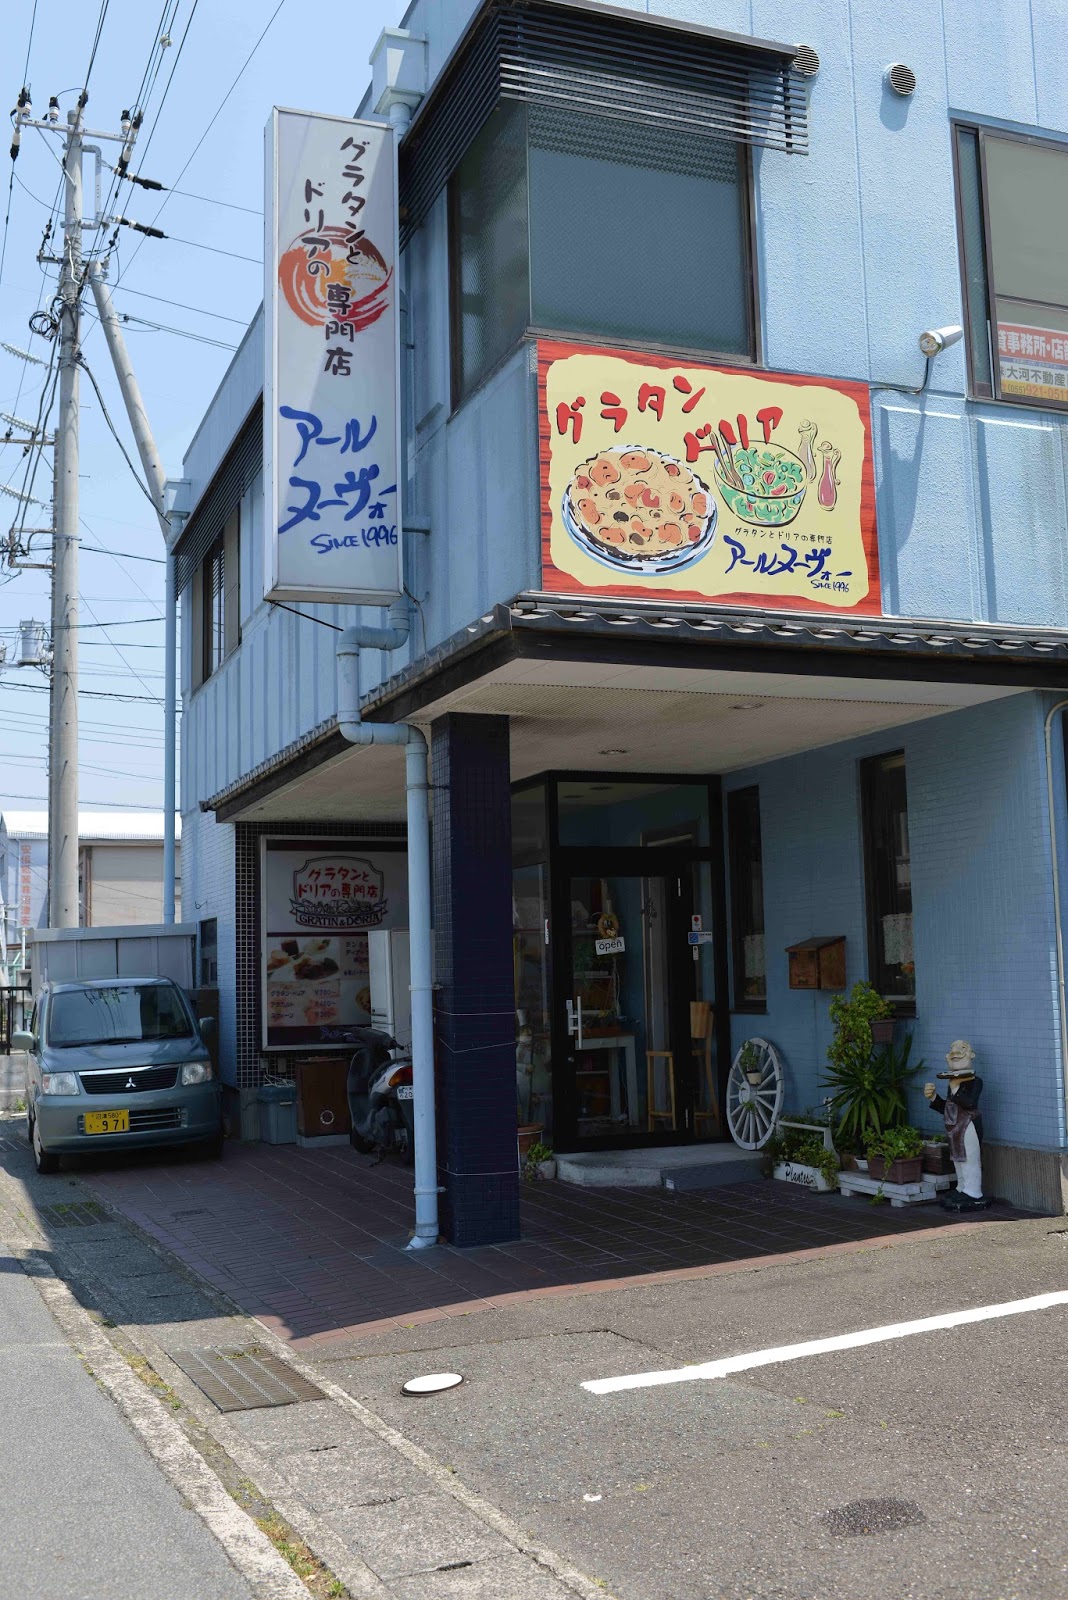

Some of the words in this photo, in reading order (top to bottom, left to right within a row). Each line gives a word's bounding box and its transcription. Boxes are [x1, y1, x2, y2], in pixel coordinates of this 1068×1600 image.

[303, 179, 331, 278] ドリアの
[341, 136, 370, 266] グラタンと
[324, 283, 355, 376] 専門店
[280, 405, 378, 467] アール
[556, 375, 705, 444] グラタン
[684, 406, 783, 463] ドリア
[362, 524, 398, 547] 1996
[734, 527, 832, 546] グラタンとドリアの専門店
[298, 883, 378, 898] ドリアの専門店
[308, 866, 369, 882] グラタンと
[599, 941, 622, 952] open
